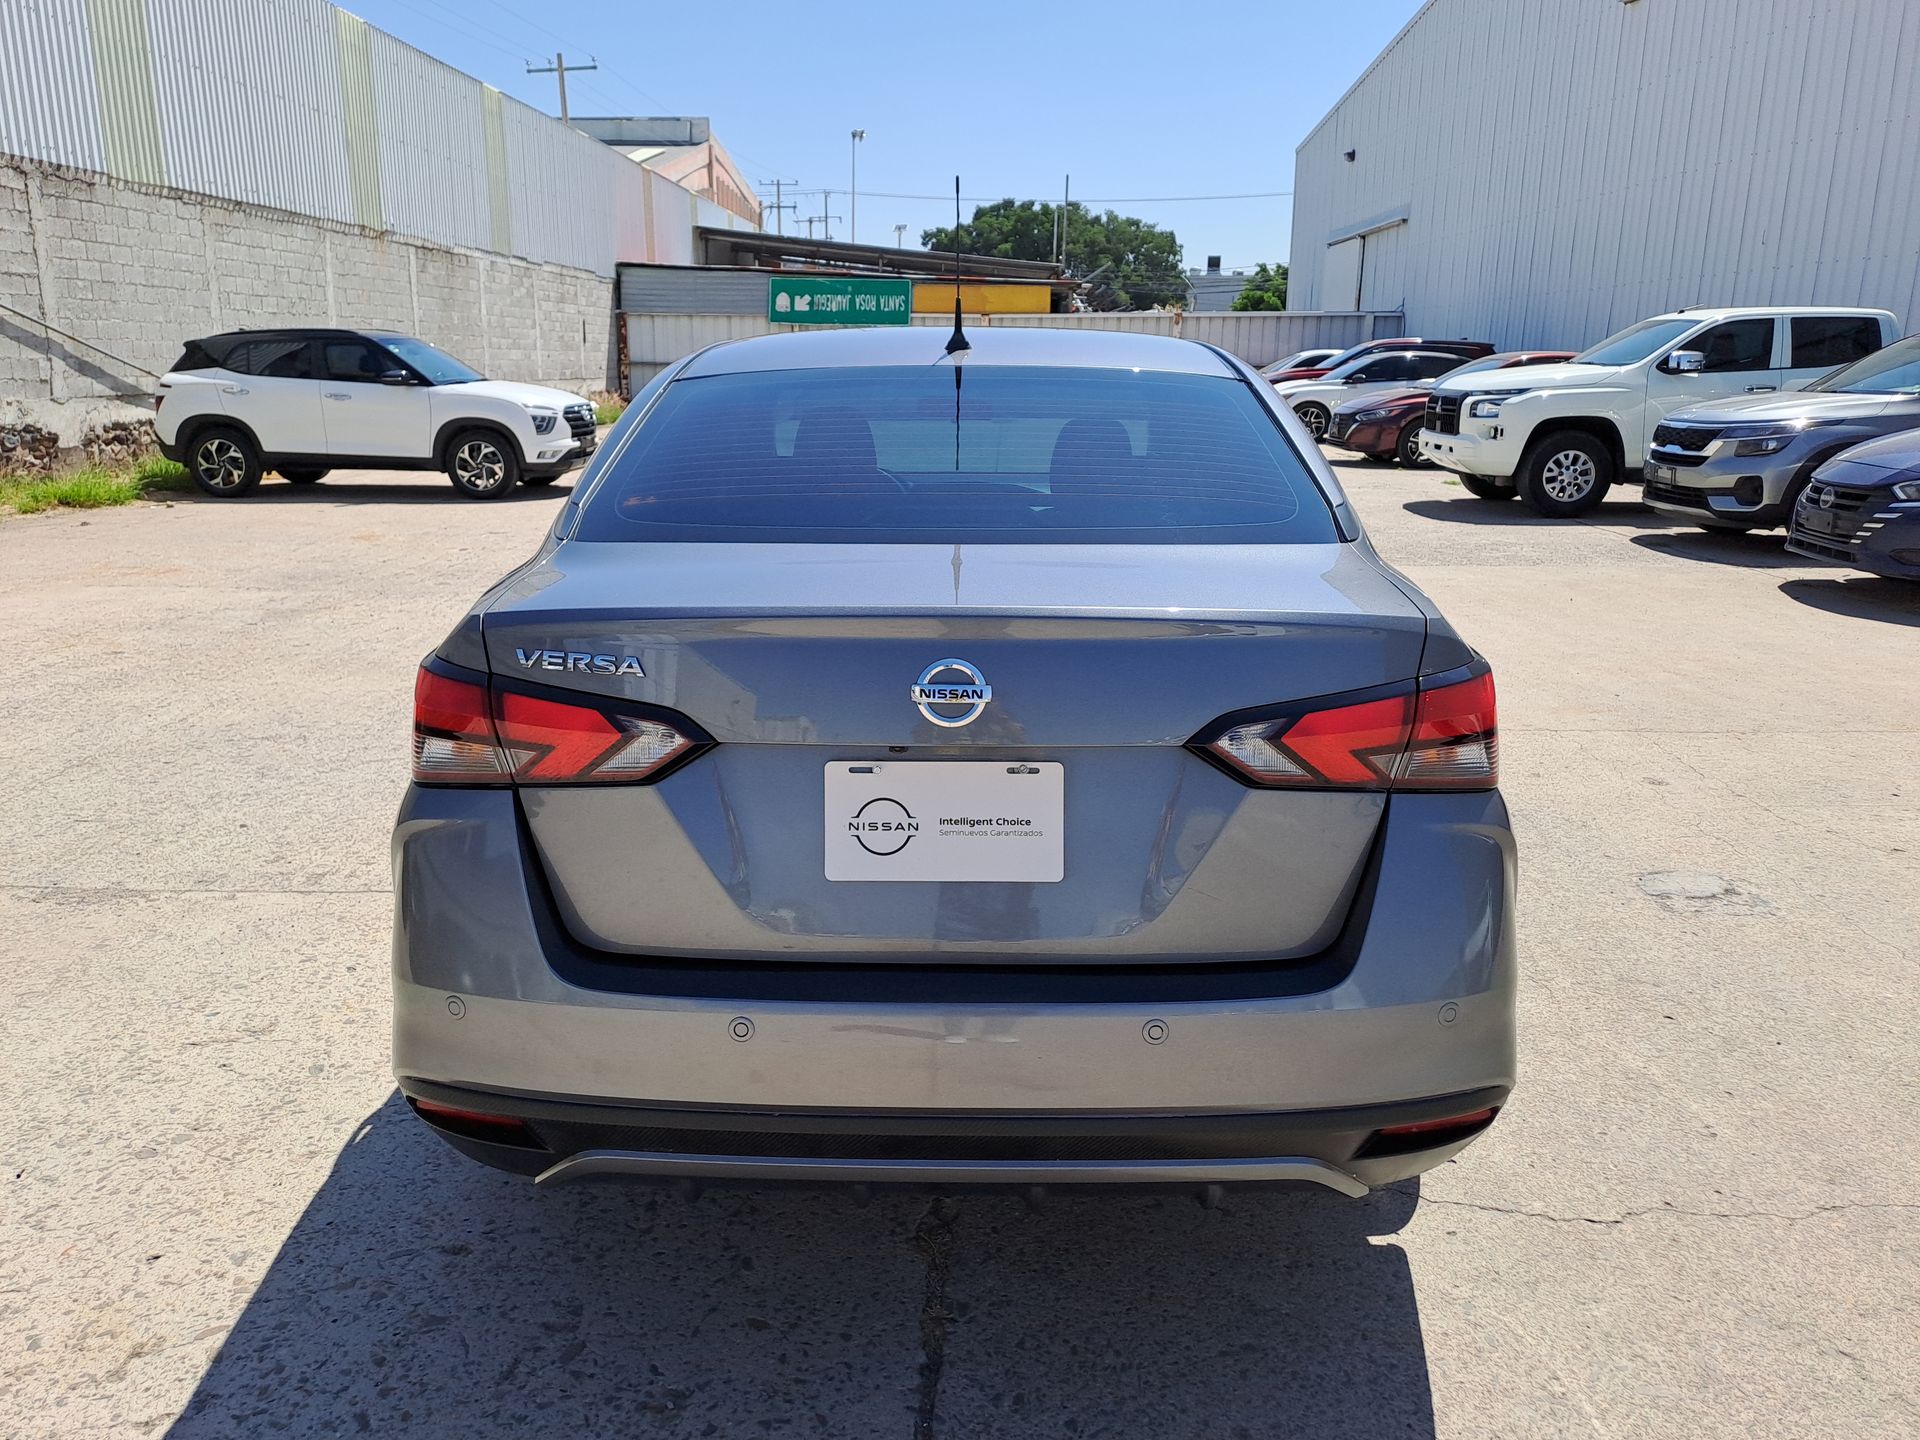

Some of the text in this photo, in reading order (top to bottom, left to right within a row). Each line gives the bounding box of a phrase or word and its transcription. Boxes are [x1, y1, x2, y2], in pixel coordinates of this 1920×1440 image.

[855, 294, 877, 312] ROSA
[880, 295, 906, 312] SANTA
[515, 648, 646, 677] VERSA
[919, 688, 984, 700] NISSAN
[848, 822, 919, 831] NISSAN
[939, 817, 1032, 827] Intelligent Choice
[939, 829, 1044, 837] Seminuevos Garantizados
